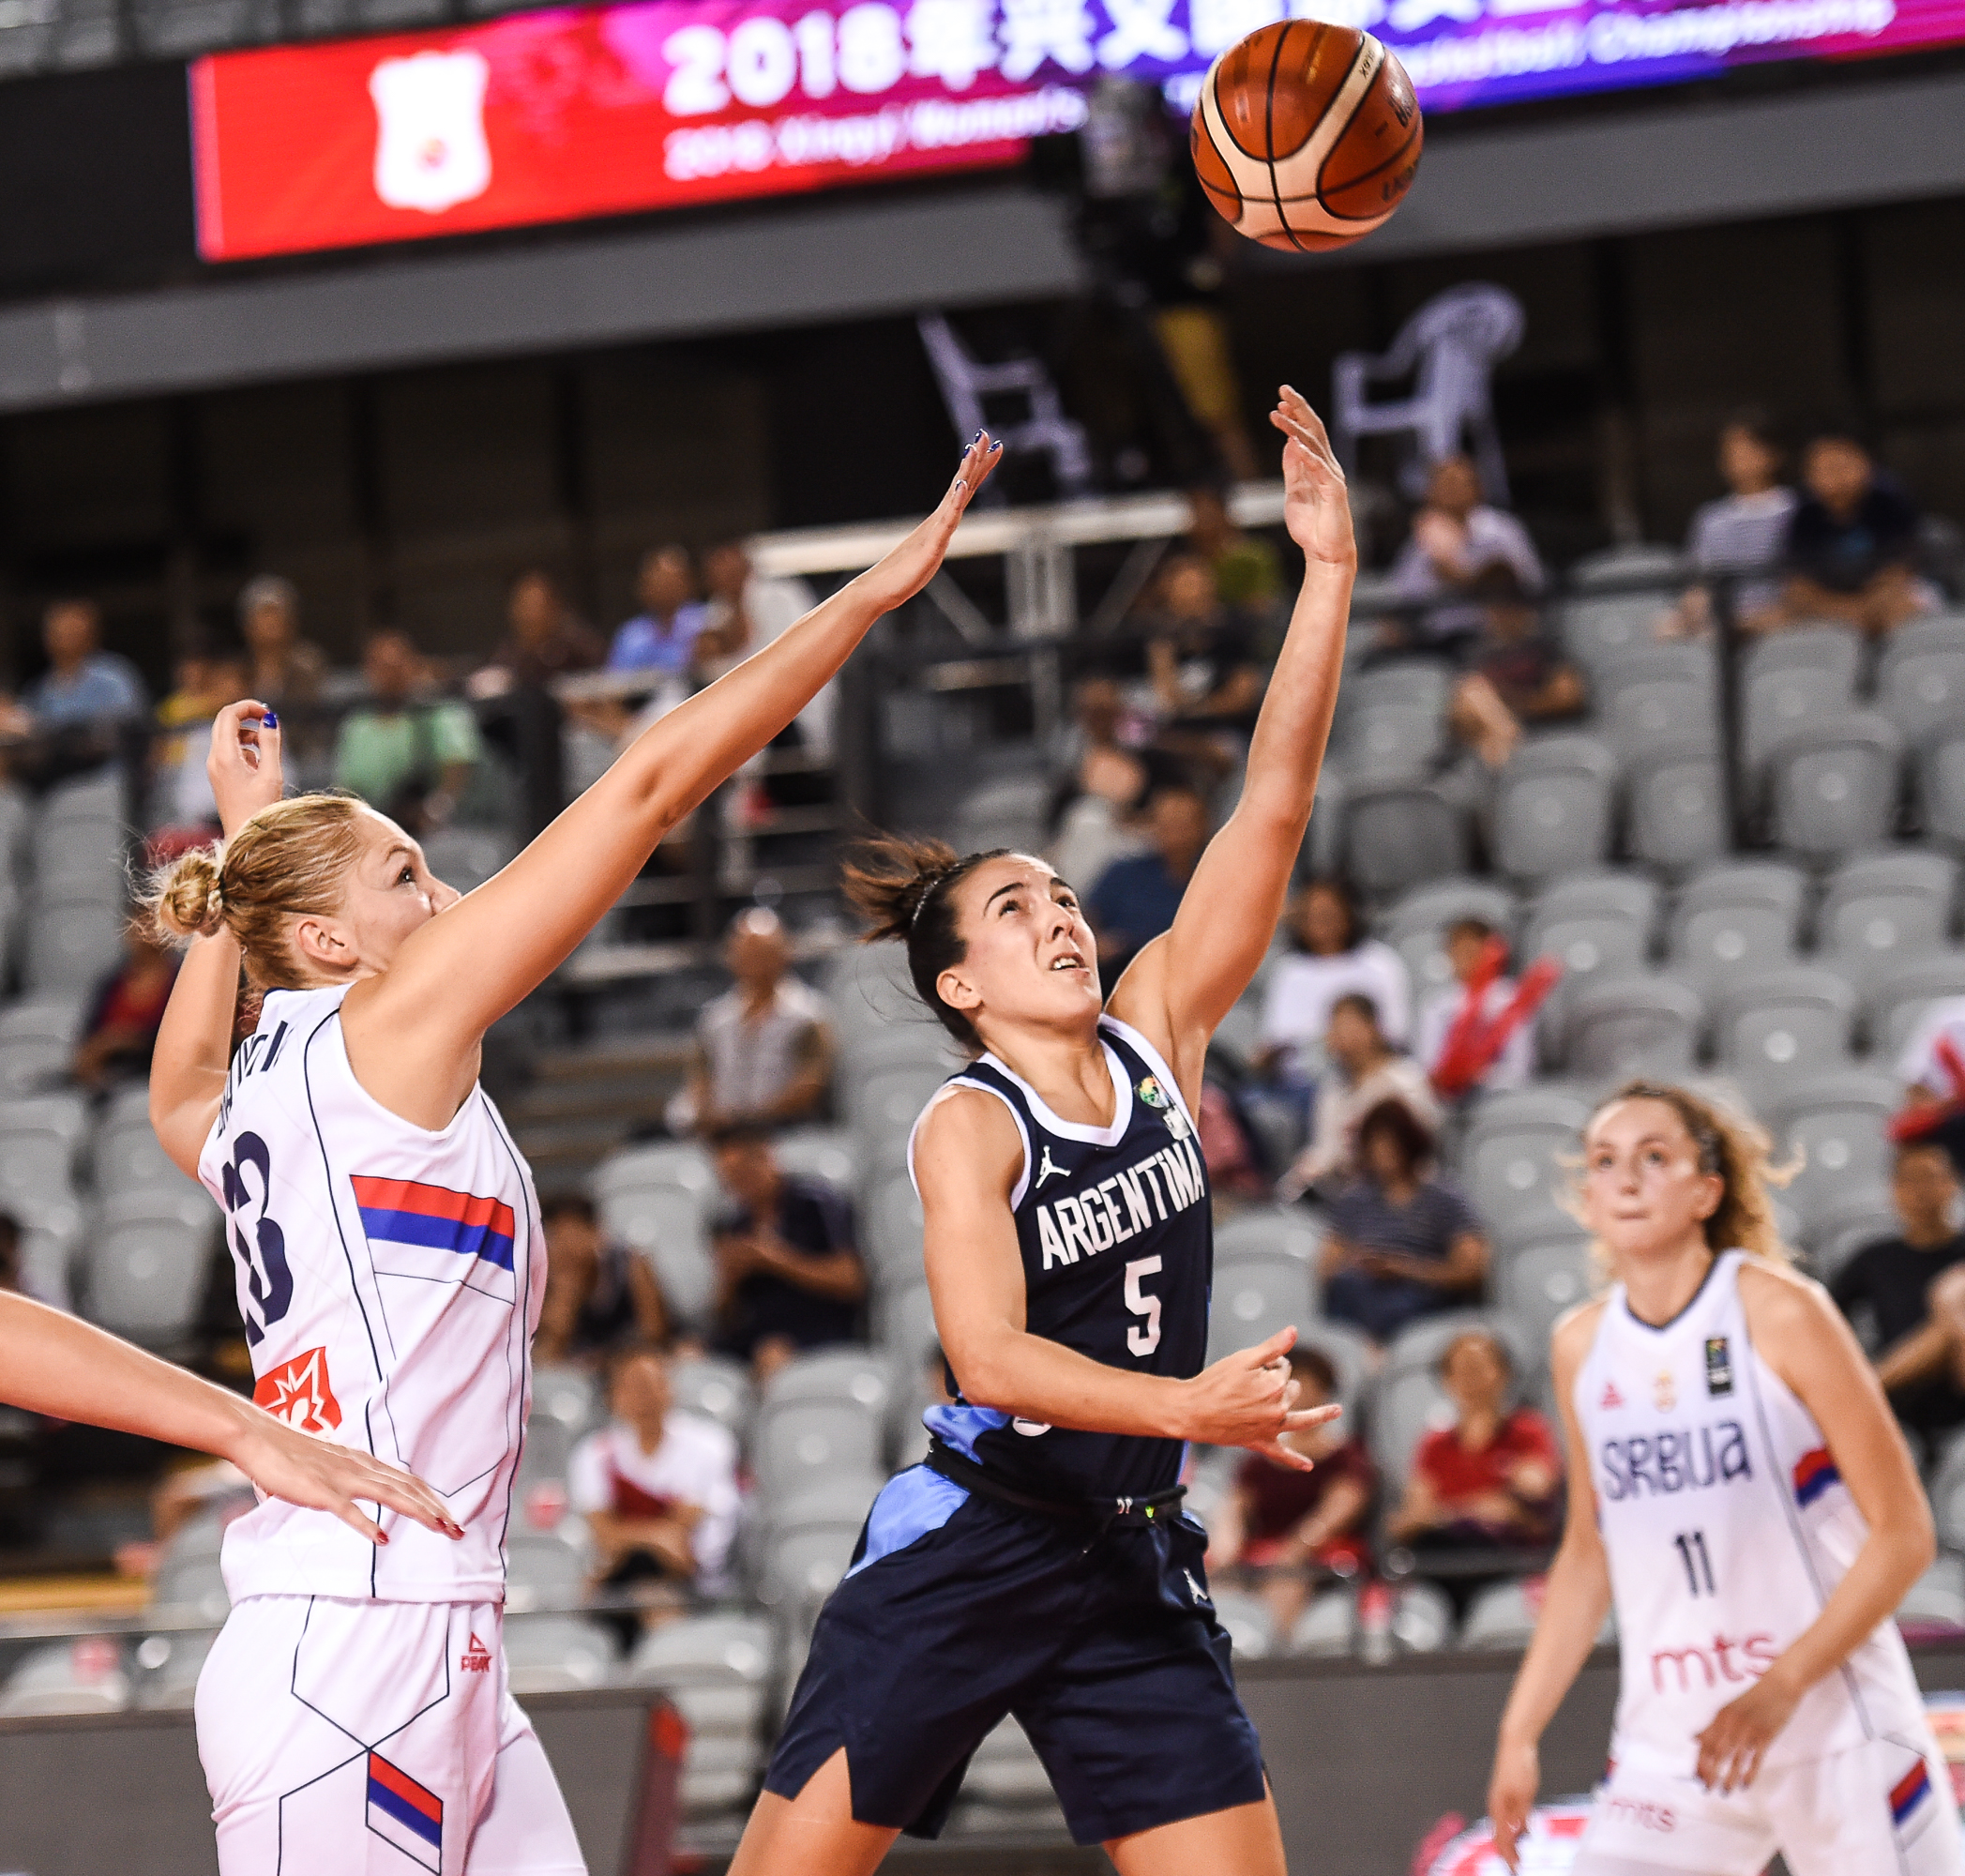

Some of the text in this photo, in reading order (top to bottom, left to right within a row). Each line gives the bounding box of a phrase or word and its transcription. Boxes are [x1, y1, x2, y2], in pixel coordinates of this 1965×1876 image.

[1035, 1138, 1205, 1270] ARGENTINA
[1125, 1254, 1163, 1357] 5
[1672, 1530, 1716, 1598] 11
[1651, 1629, 1776, 1694] mts
